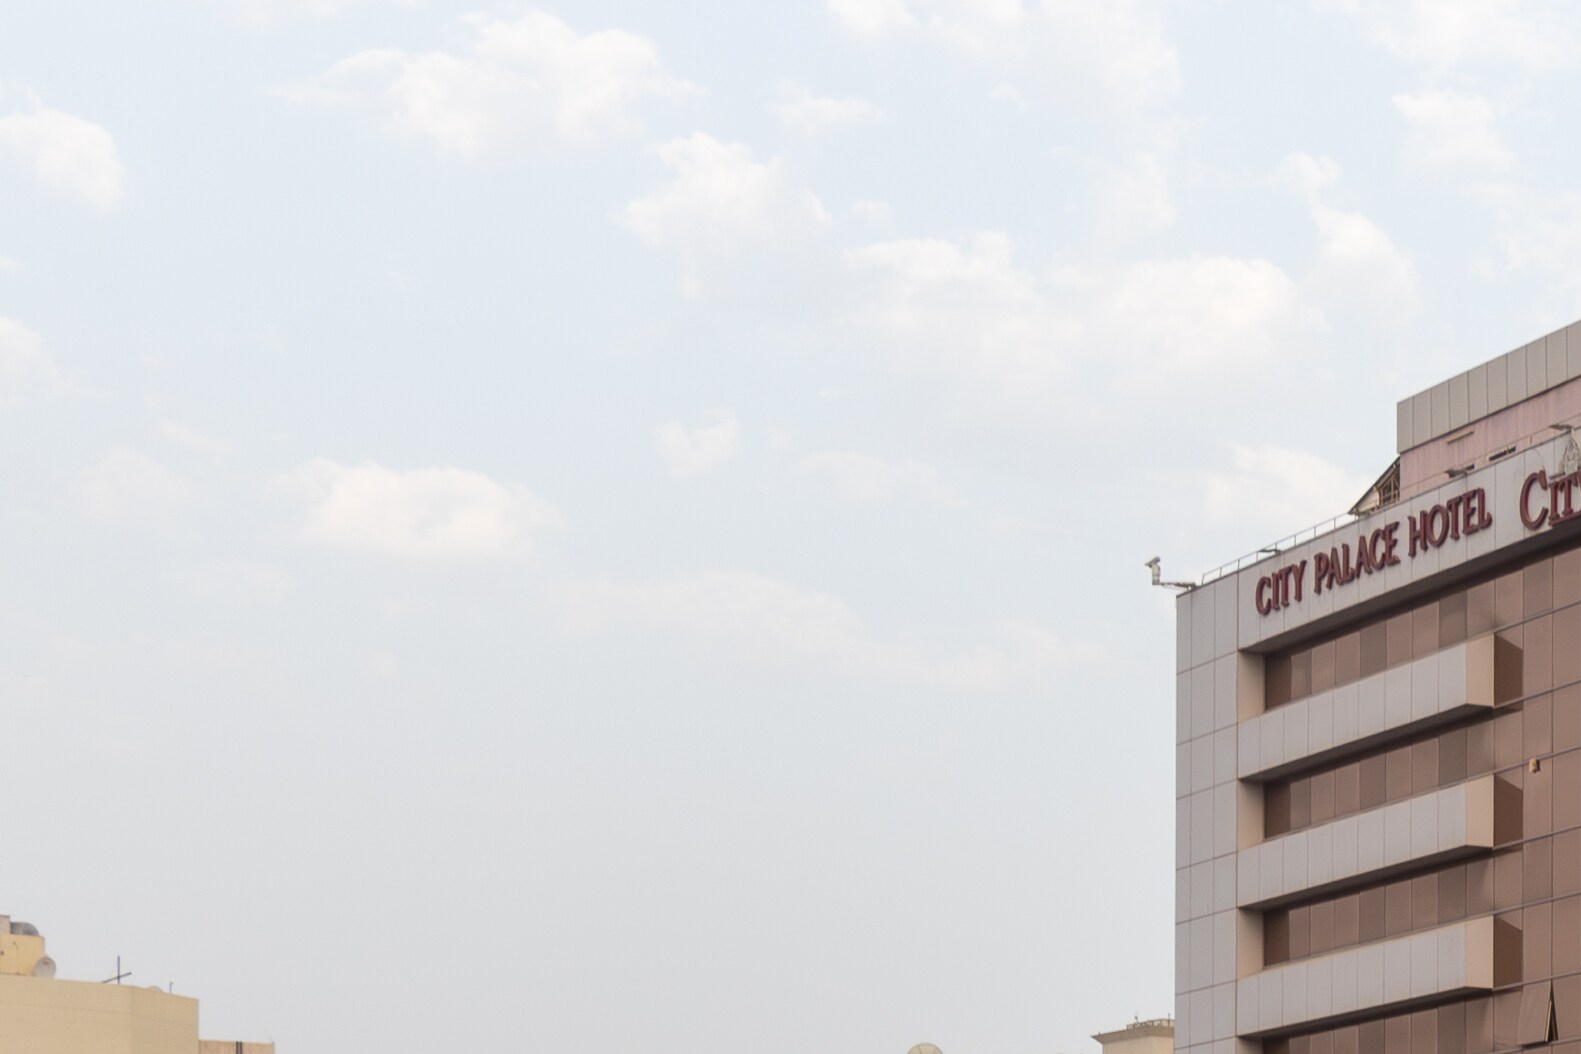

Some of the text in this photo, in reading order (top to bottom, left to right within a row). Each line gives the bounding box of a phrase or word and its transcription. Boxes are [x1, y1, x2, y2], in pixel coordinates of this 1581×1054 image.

[1255, 487, 1493, 616] CITY PALACE HOTEL
